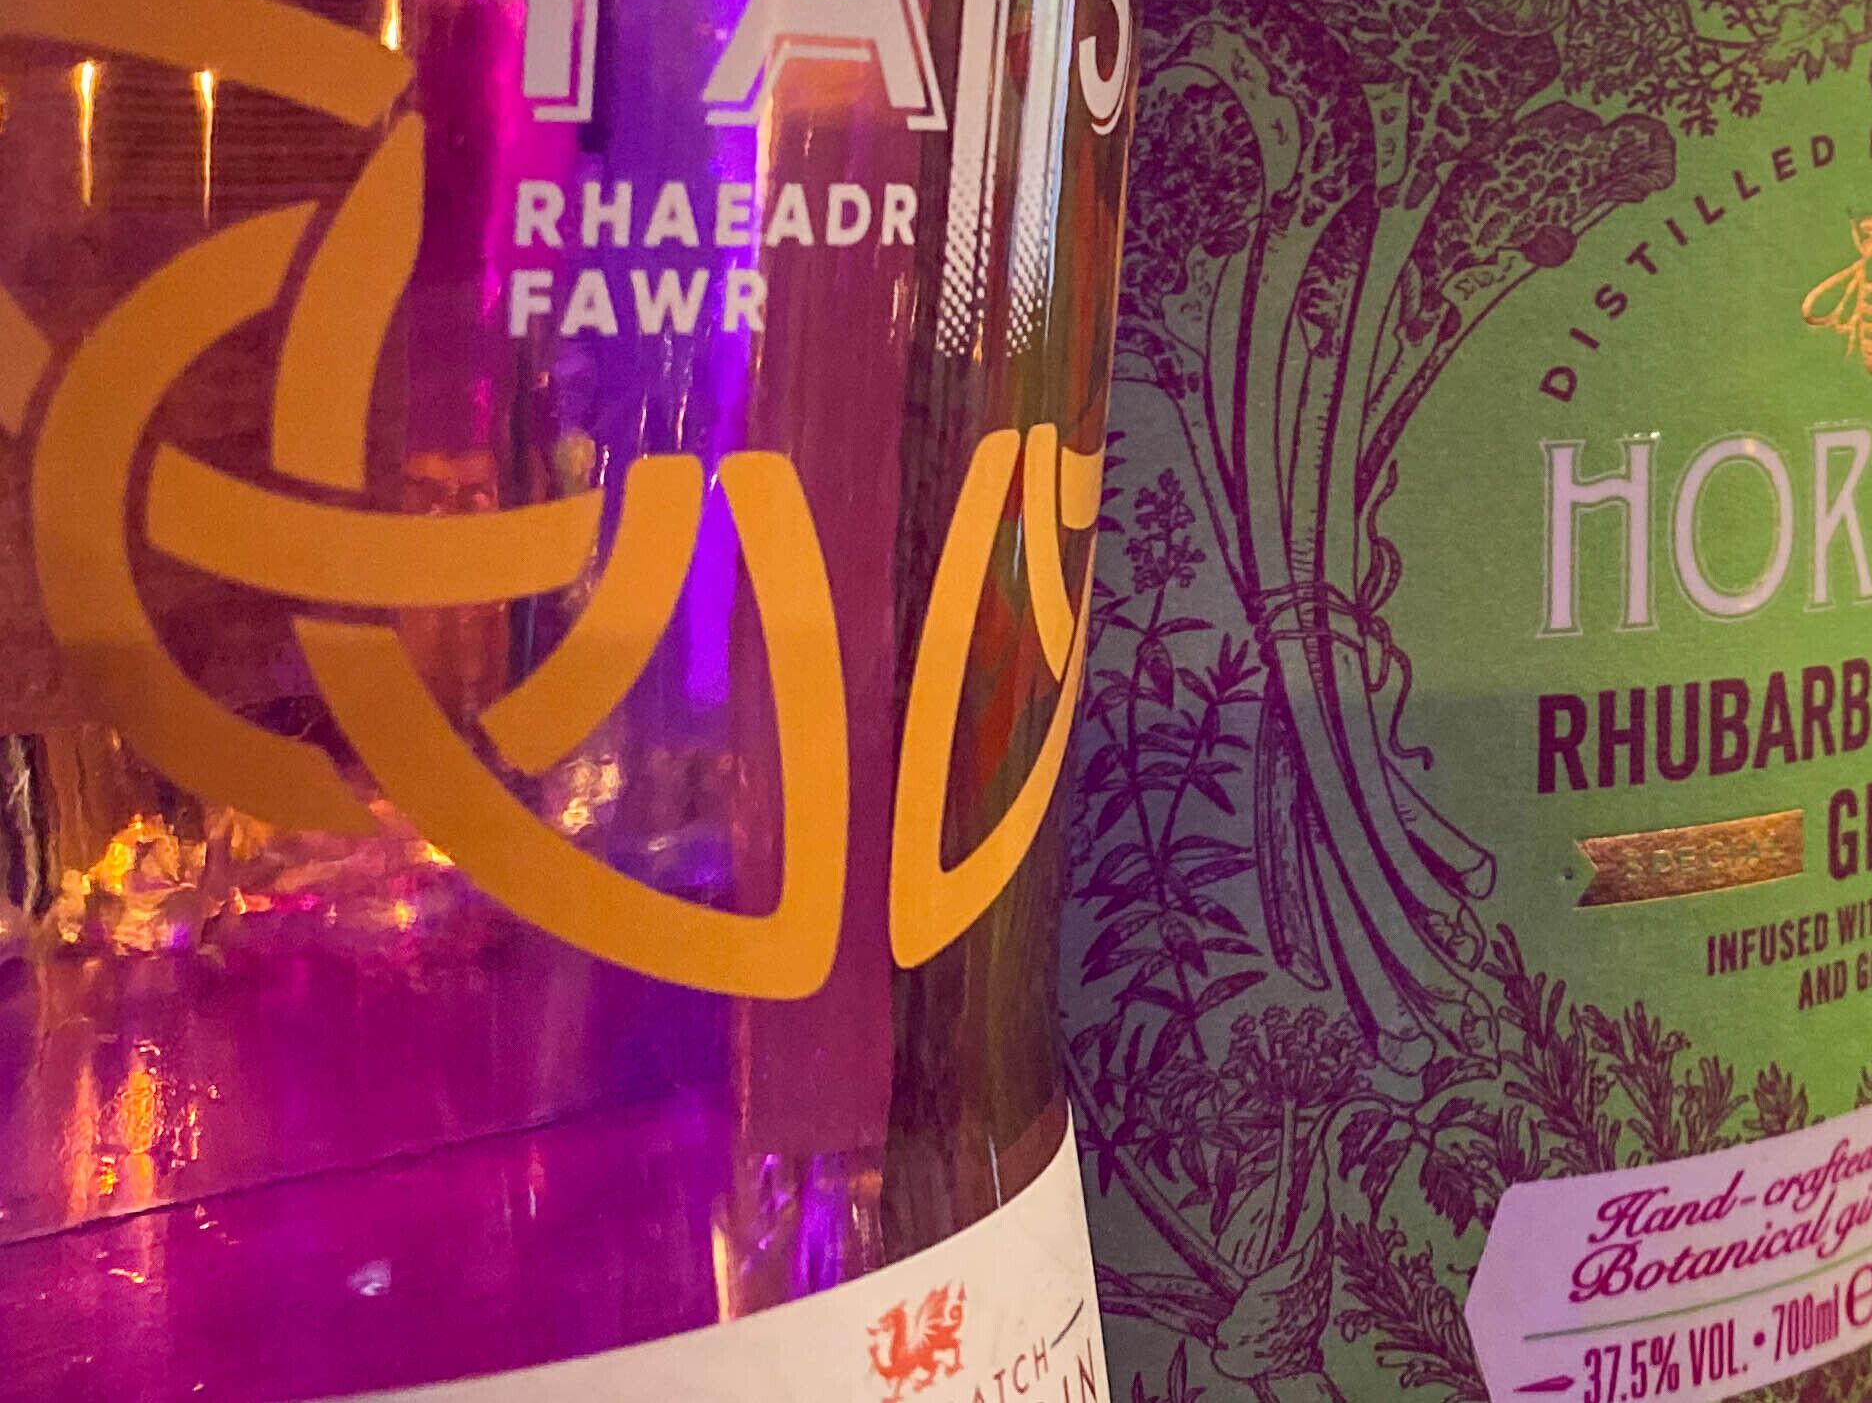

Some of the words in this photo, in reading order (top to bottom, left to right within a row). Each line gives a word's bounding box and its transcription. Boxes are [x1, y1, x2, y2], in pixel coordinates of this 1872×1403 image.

[514, 178, 918, 251] RHAEADR
[508, 268, 768, 337] FAWR
[1539, 133, 1835, 402] DISTILLED
[1537, 656, 1871, 796] RHUBARB
[1707, 912, 1829, 976] INFUSED
[1798, 959, 1847, 1011] AND
[1568, 1188, 1836, 1304] Botanical
[1583, 1331, 1681, 1403] 37.5%
[1772, 1282, 1840, 1363] 700ml
